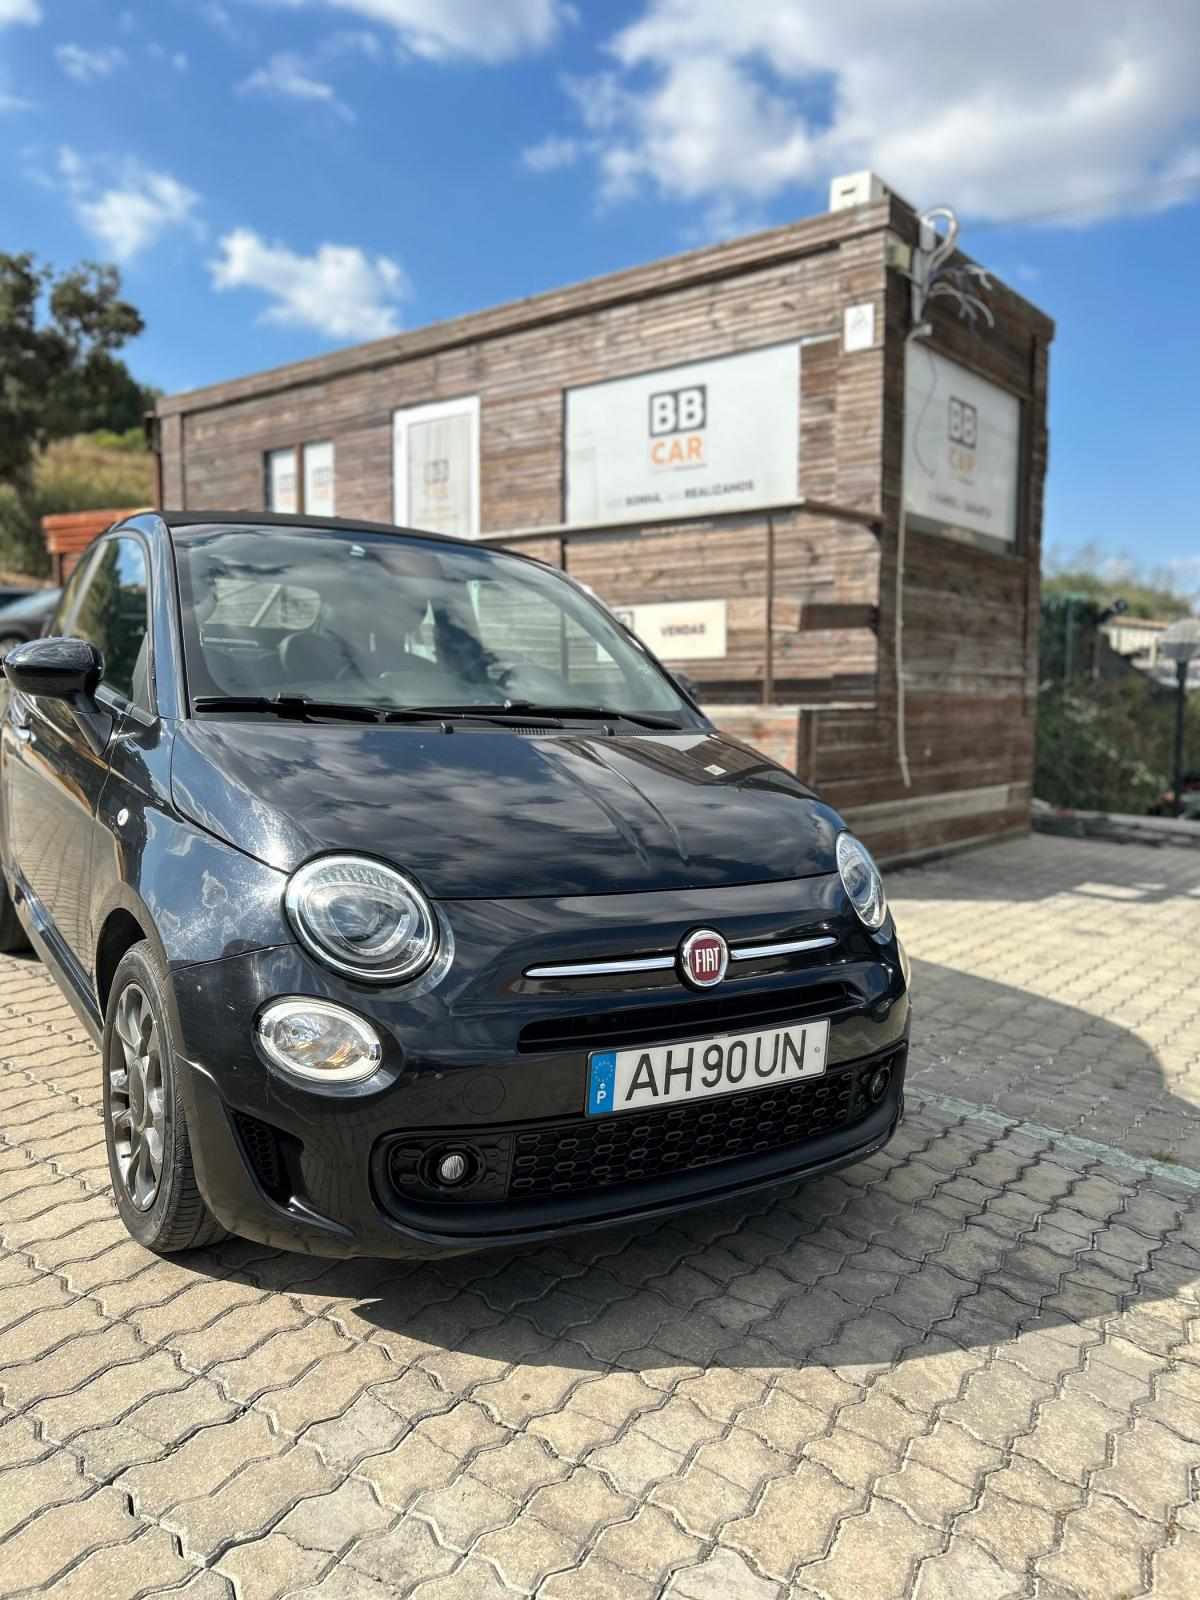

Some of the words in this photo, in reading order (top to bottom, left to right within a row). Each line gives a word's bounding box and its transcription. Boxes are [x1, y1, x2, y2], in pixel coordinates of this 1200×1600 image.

[652, 388, 705, 435] BB
[651, 436, 702, 464] CAR
[661, 623, 706, 637] VENDAS
[693, 946, 720, 974] FIAT
[596, 1090, 607, 1105] P
